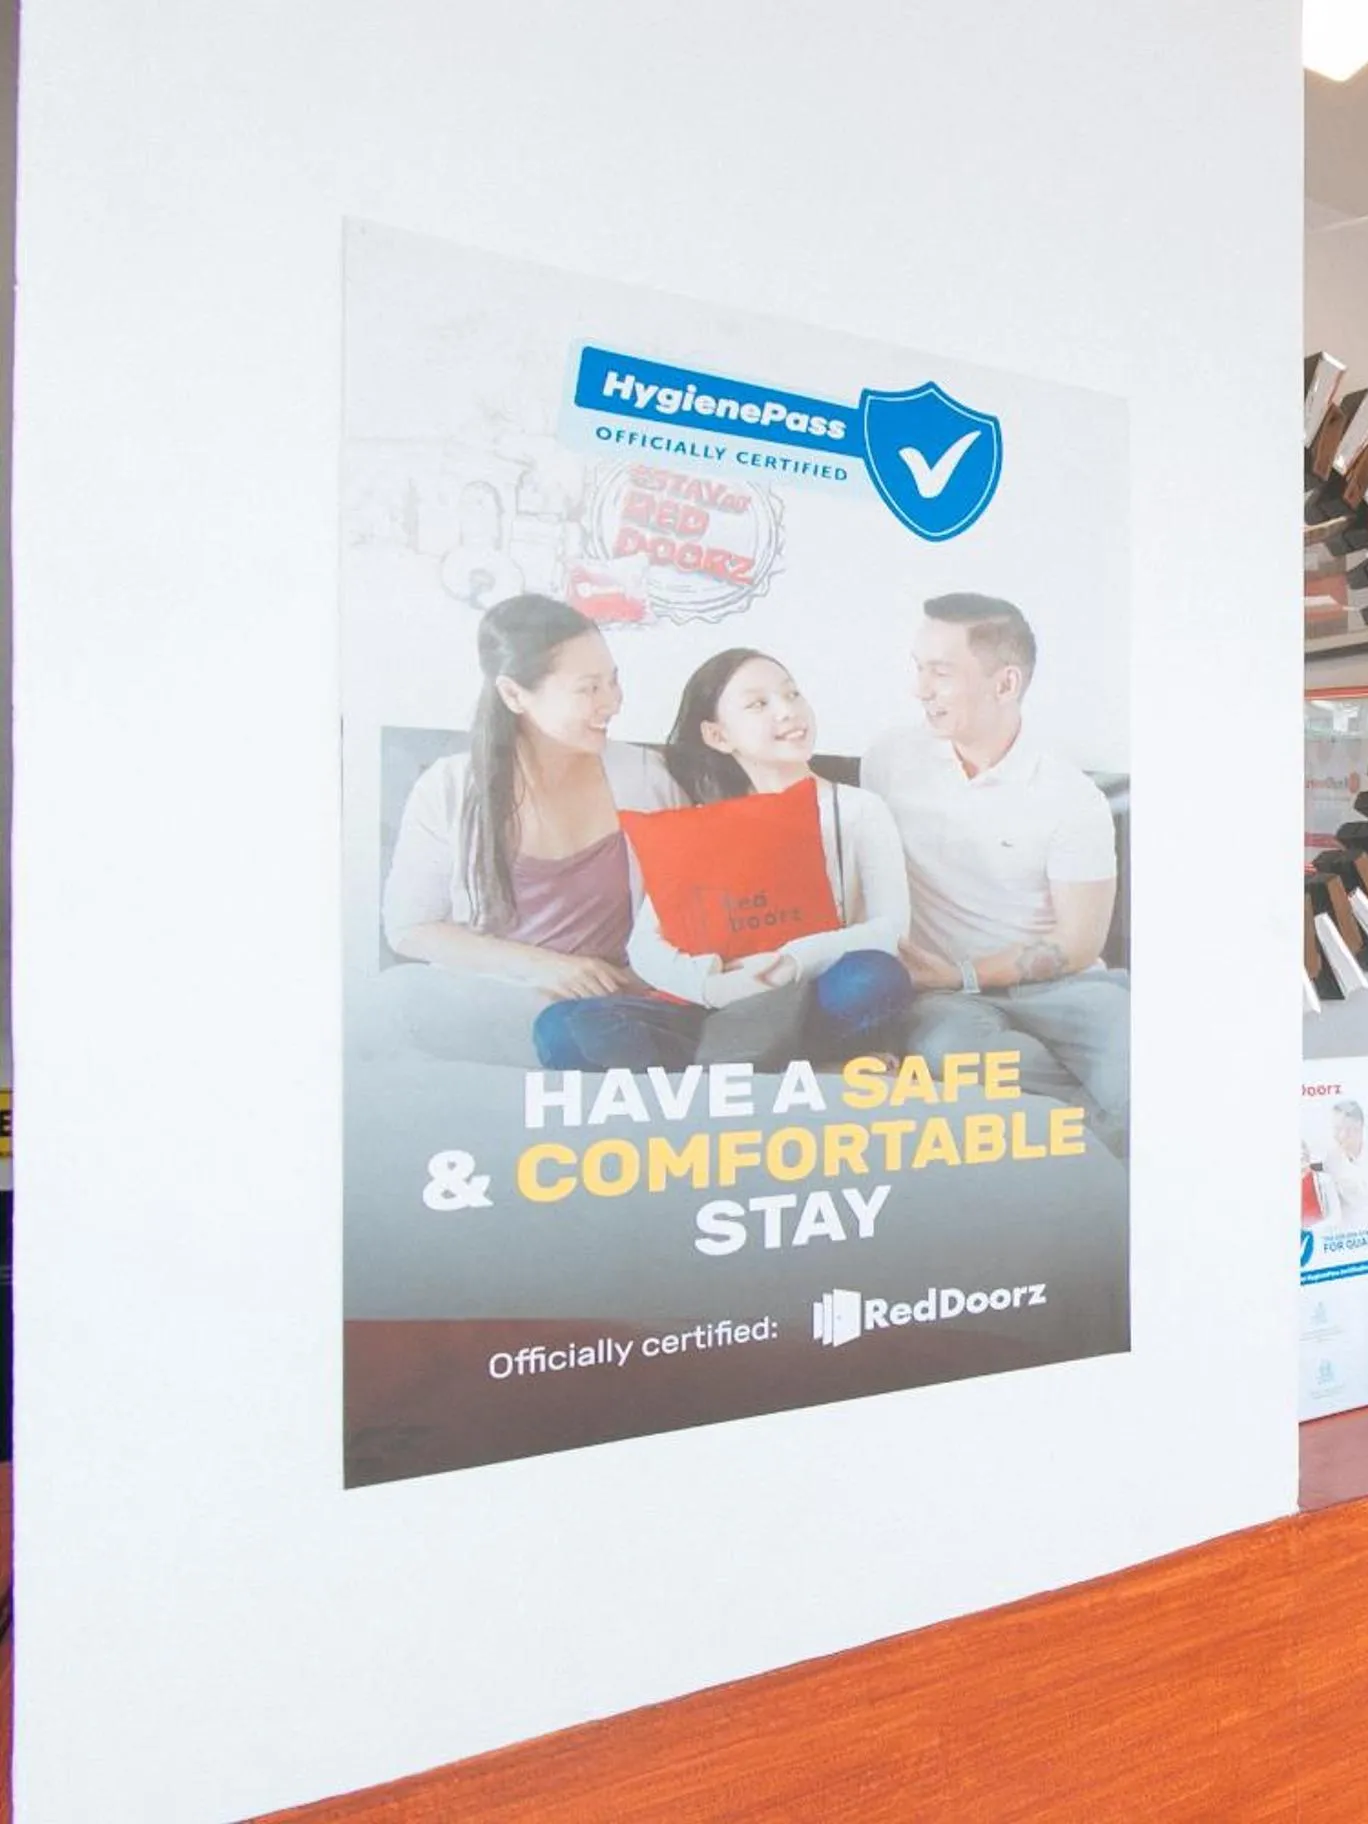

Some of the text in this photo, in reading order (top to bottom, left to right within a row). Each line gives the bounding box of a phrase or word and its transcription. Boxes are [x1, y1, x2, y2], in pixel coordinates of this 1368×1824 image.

[602, 370, 847, 440] HygienePass
[595, 426, 848, 483] OFFICIALLY CERTIFIED
[622, 490, 710, 538] RED
[614, 525, 756, 588] DOORZ
[525, 1049, 1022, 1128] HAVE A SAFE
[422, 1107, 1086, 1211] & COMFORTABLE
[695, 1185, 891, 1256] STAY
[489, 1281, 1047, 1380] Officially certified: RedDoorz
